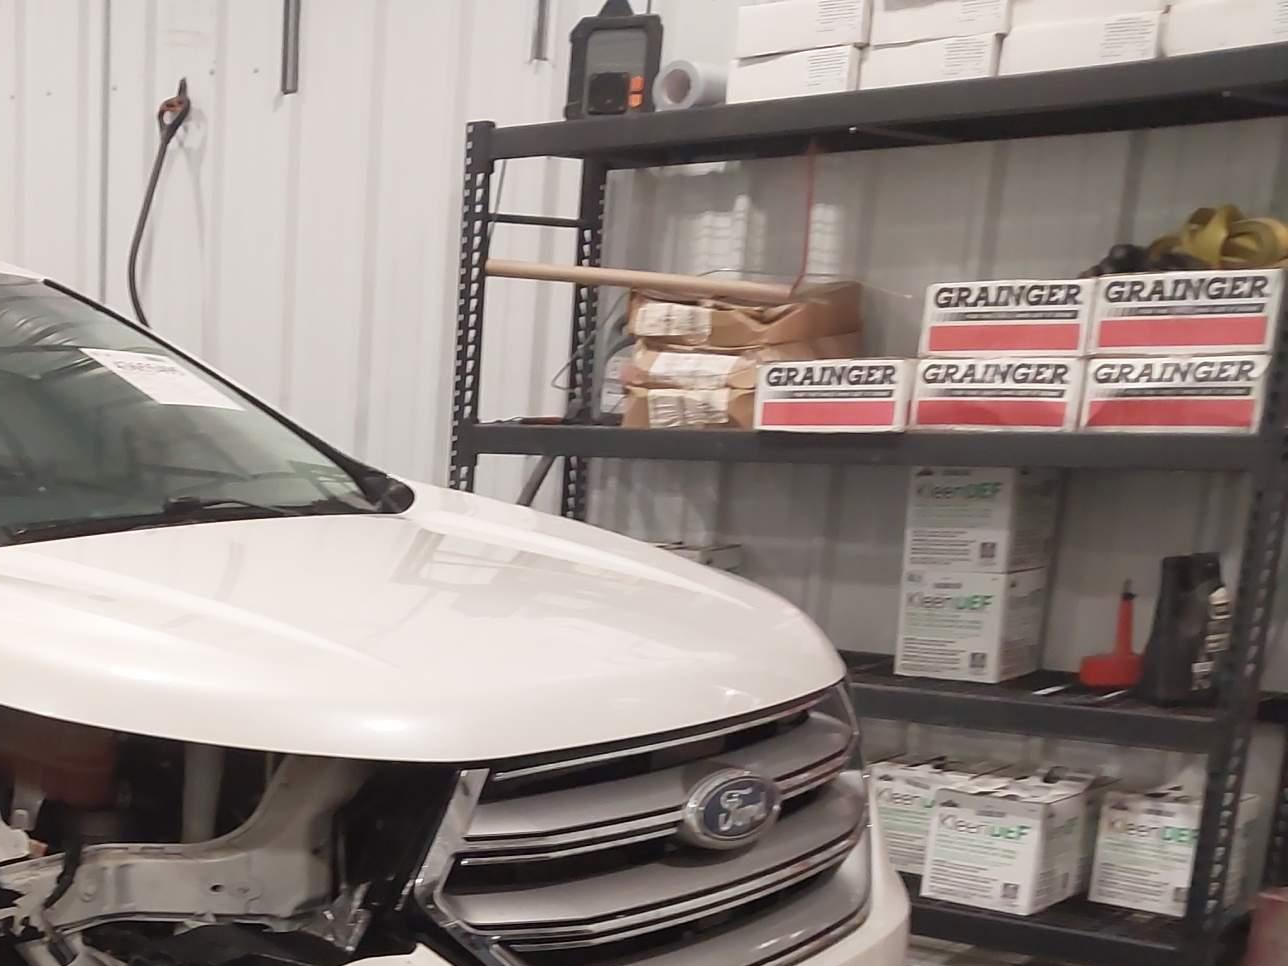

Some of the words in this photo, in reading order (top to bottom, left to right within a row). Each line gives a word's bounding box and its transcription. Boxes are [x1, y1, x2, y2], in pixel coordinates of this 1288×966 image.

[934, 284, 1082, 309] GRAINGER
[1105, 276, 1270, 303] GRAINGER
[766, 364, 897, 387] GRAINGER
[922, 362, 1070, 385] GRAINGER
[1093, 360, 1256, 384] GRAINGER
